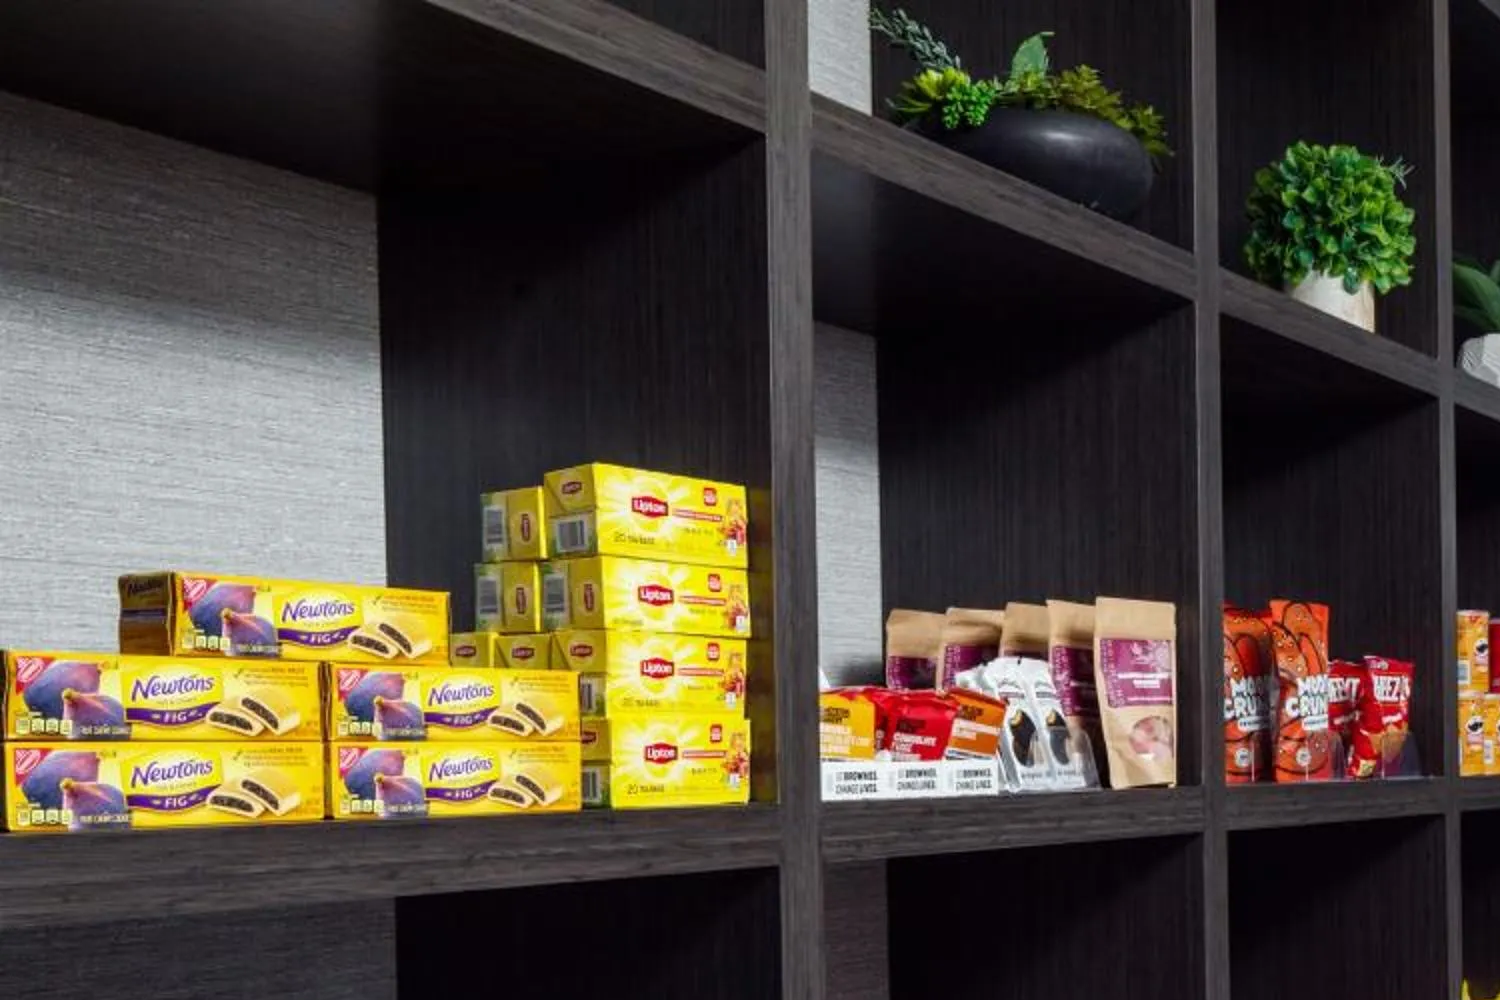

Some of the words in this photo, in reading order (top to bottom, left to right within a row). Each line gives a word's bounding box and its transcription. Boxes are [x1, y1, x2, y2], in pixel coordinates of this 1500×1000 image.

[635, 498, 667, 513] Lipton
[642, 588, 671, 602] Lipton
[281, 599, 355, 623] Newtons
[310, 633, 331, 644] FIG
[643, 661, 673, 675] Lipton
[131, 675, 215, 702] Newtons
[427, 681, 494, 707] Newtons
[164, 711, 187, 723] FIG
[647, 747, 676, 761] Lipton
[131, 760, 213, 789] Newtons
[429, 754, 493, 781] Newtons
[164, 796, 188, 808] FIG
